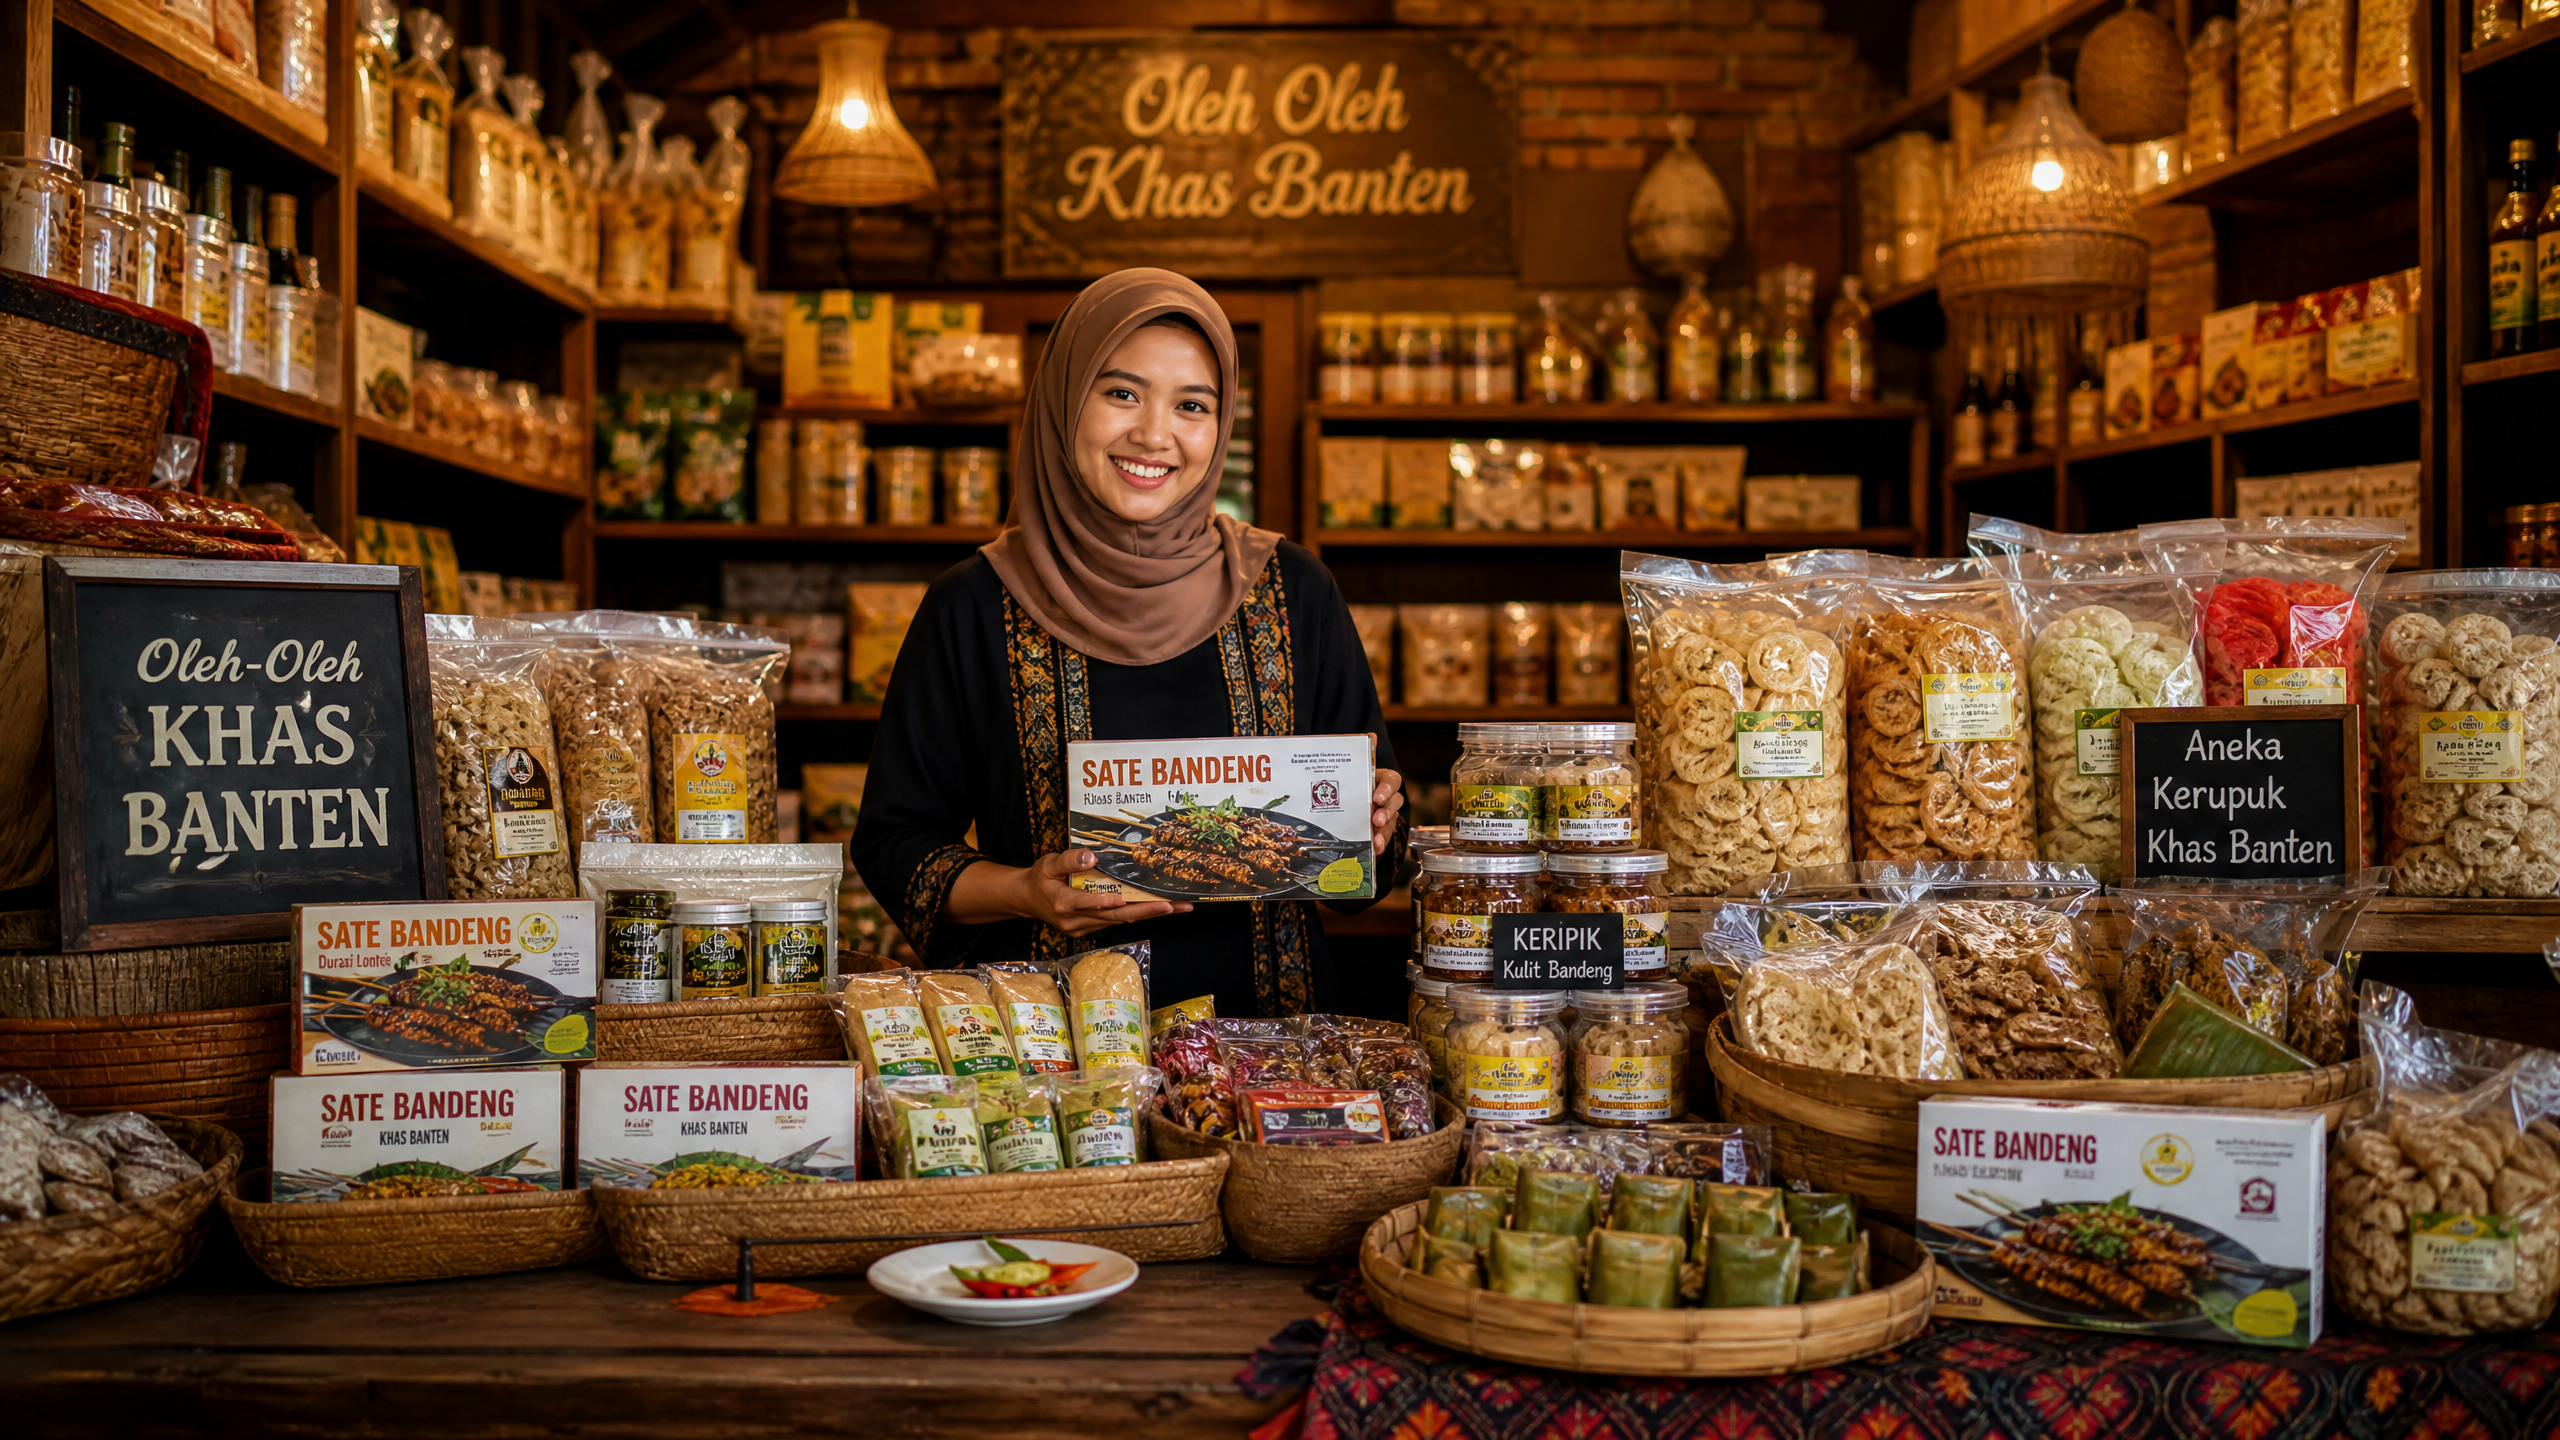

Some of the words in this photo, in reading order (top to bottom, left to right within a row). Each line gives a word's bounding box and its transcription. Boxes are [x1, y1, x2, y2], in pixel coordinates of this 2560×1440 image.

[1121, 63, 1259, 138] Oleh
[1273, 62, 1411, 137] Oleh
[1057, 144, 1237, 222] Khas
[1248, 141, 1474, 219] Banten
[137, 638, 363, 683] Oleh-Oleh
[148, 704, 355, 767] KHAS
[2184, 728, 2284, 761] Aneka
[1083, 758, 1142, 787] SATE
[1152, 754, 1271, 785] BANDENG
[2153, 775, 2286, 821] Kerupuk
[123, 787, 390, 855] BANTEN
[2148, 828, 2217, 863] Khas
[2229, 828, 2335, 863] Banten
[318, 920, 381, 950] SATE
[390, 916, 511, 948] BANDENG
[1513, 924, 1602, 950] KERIPIK
[1503, 960, 1541, 979] Kulit
[1549, 960, 1613, 984] Bandeng
[321, 1093, 384, 1123] SATE
[394, 1089, 514, 1120] BANDENG
[624, 1085, 680, 1112] SATE
[689, 1084, 808, 1111] BANDENG
[379, 1130, 407, 1146] KHAS
[409, 1129, 450, 1145] BANTEN
[681, 1121, 707, 1136] KHAS
[709, 1121, 748, 1135] BANTEN
[1934, 1127, 1986, 1158] SATE
[1994, 1130, 2097, 1164] BANDENG
